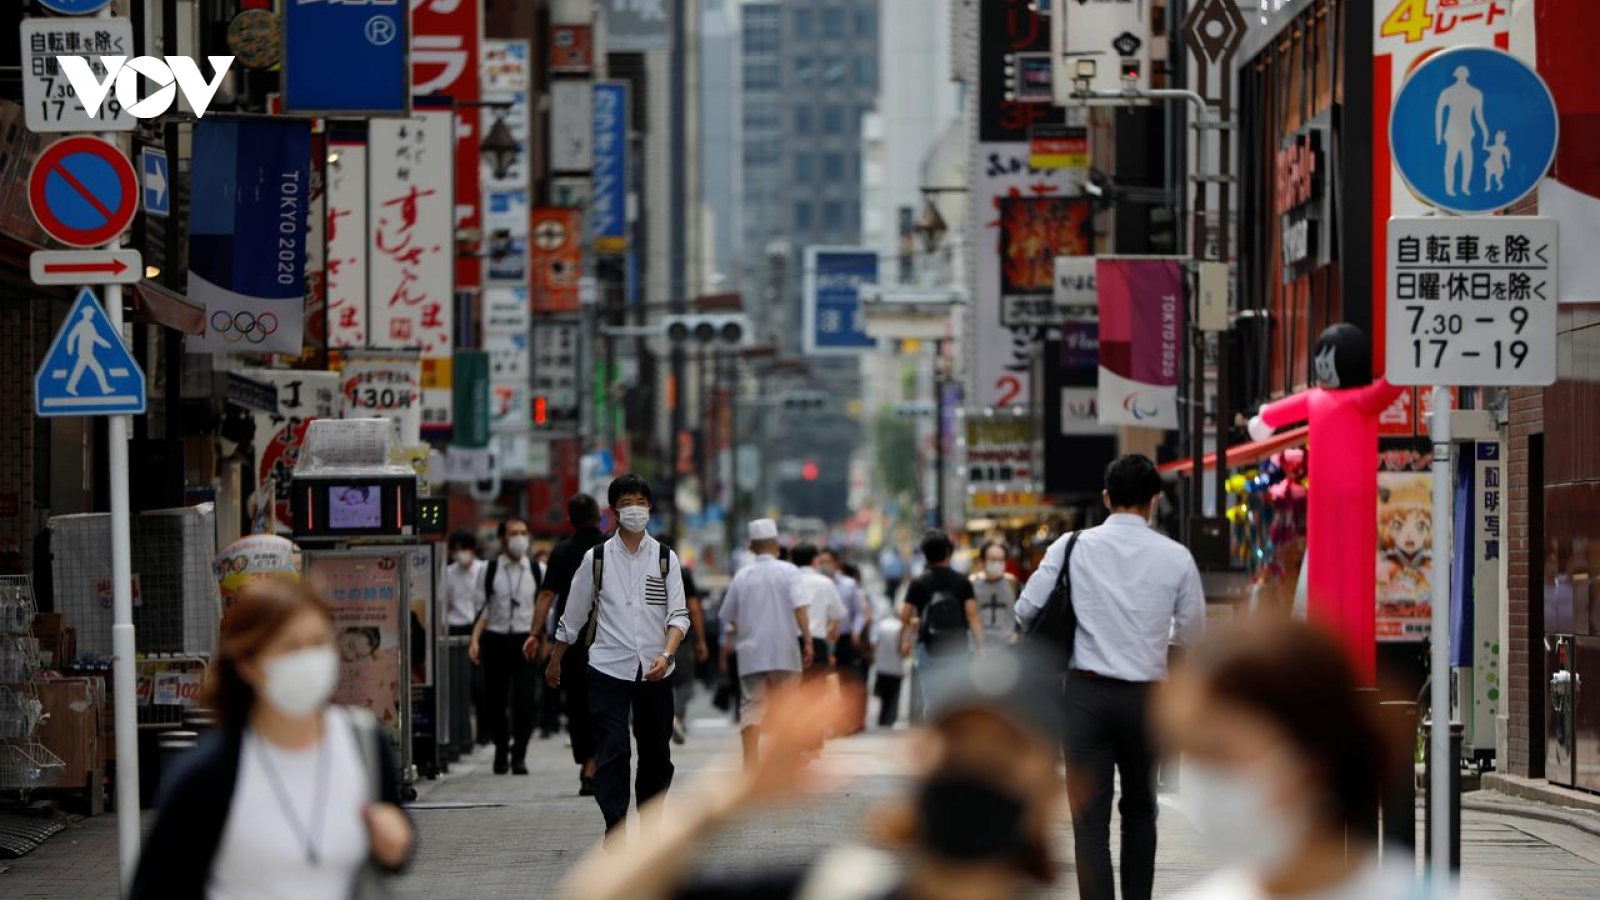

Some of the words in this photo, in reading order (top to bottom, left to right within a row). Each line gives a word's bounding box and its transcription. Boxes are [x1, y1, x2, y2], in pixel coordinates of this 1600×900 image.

[1380, 0, 1434, 43] 4
[1434, 2, 1506, 34] レート
[30, 31, 124, 52] 自転車を除く
[42, 101, 65, 121] 17
[99, 101, 121, 121] 19
[279, 171, 300, 234] TOKYO
[278, 238, 296, 285] 2020
[1397, 235, 1548, 263] 自転車を除く
[374, 185, 449, 353] すしざんまい
[1397, 273, 1547, 301] 日曜・休日を除く
[1161, 295, 1176, 340] TOKYO
[1405, 306, 1462, 335] 7.30
[1509, 306, 1529, 335] 9
[1161, 341, 1176, 377] 2020
[1413, 340, 1448, 368] 17
[1494, 340, 1529, 368] 19
[1484, 467, 1500, 561] 証明写真
